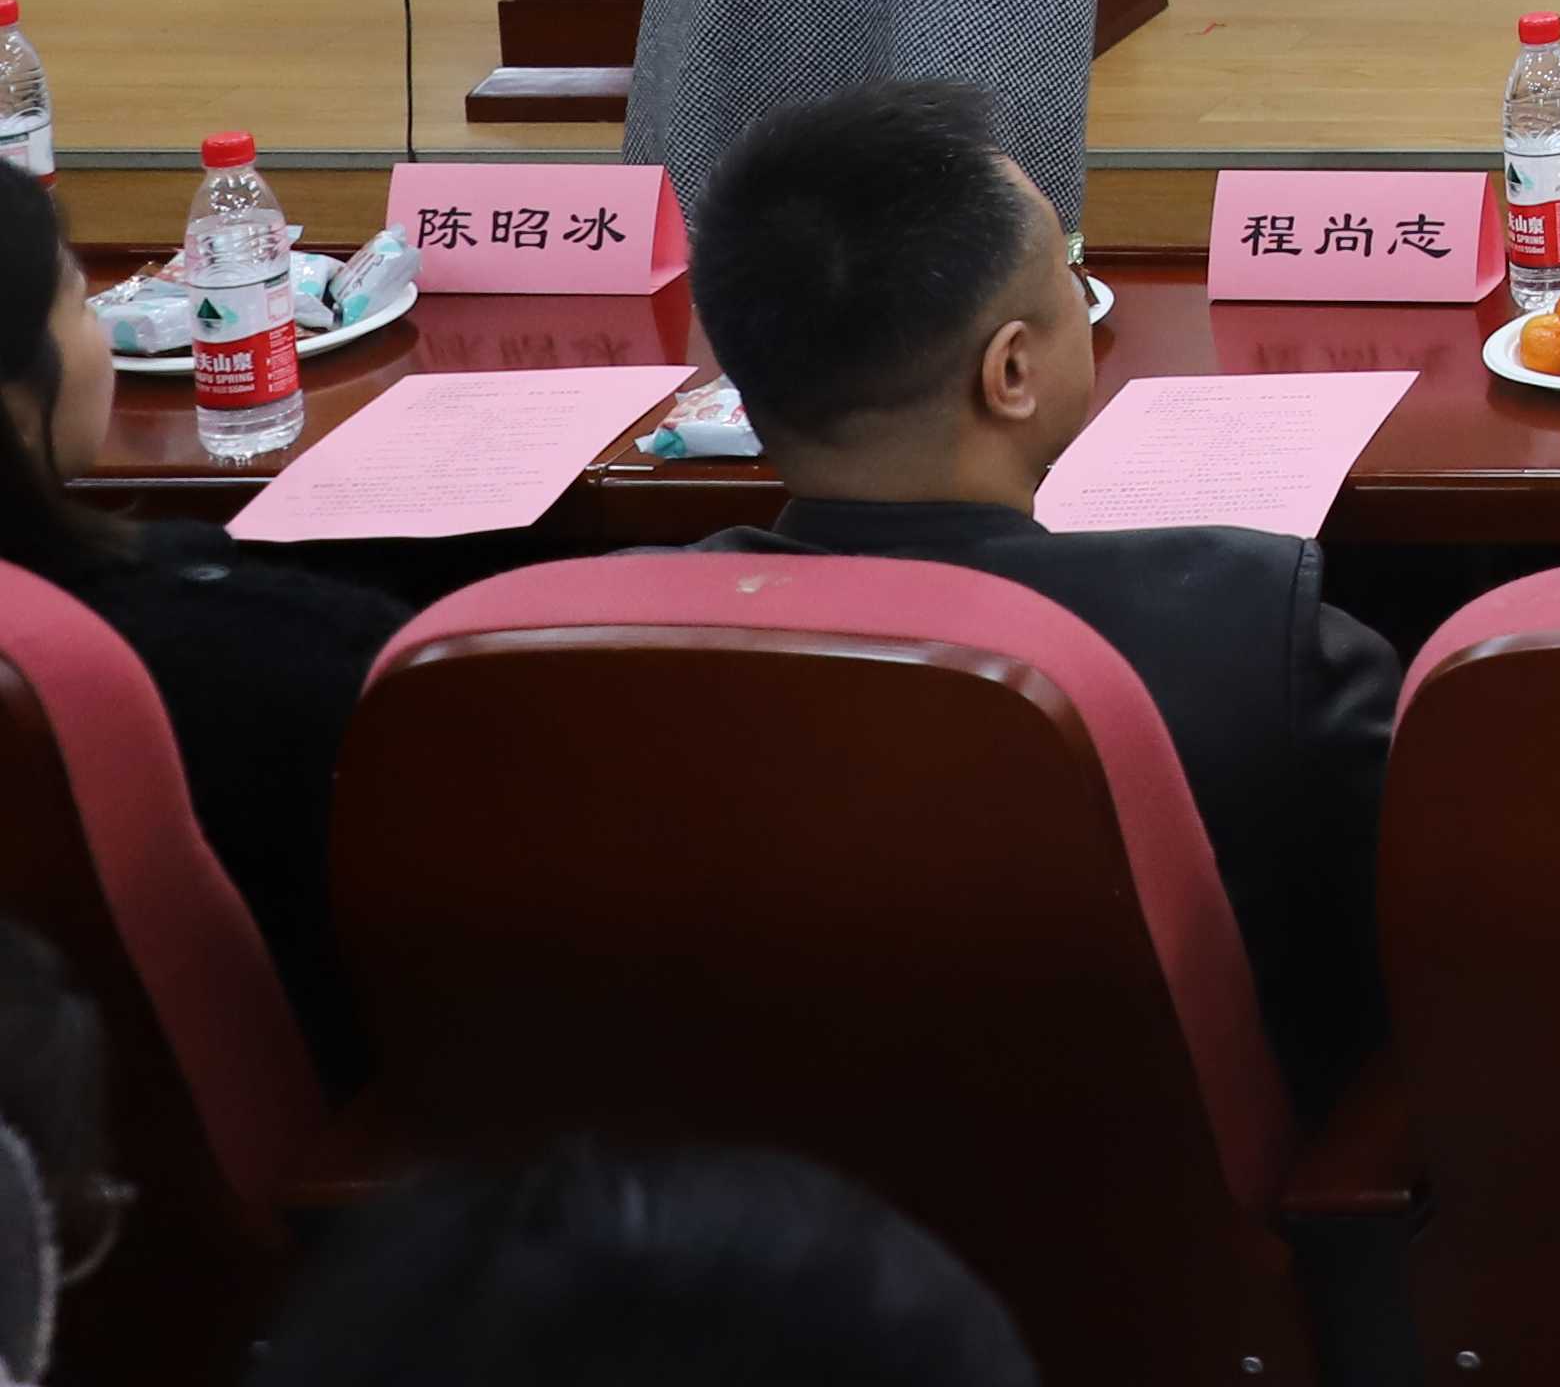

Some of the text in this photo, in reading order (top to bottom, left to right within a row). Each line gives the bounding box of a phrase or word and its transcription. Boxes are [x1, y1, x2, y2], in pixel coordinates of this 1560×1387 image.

[416, 206, 627, 252] 陈昭冰
[1240, 212, 1452, 259] 程尚志
[215, 371, 255, 384] SPRING
